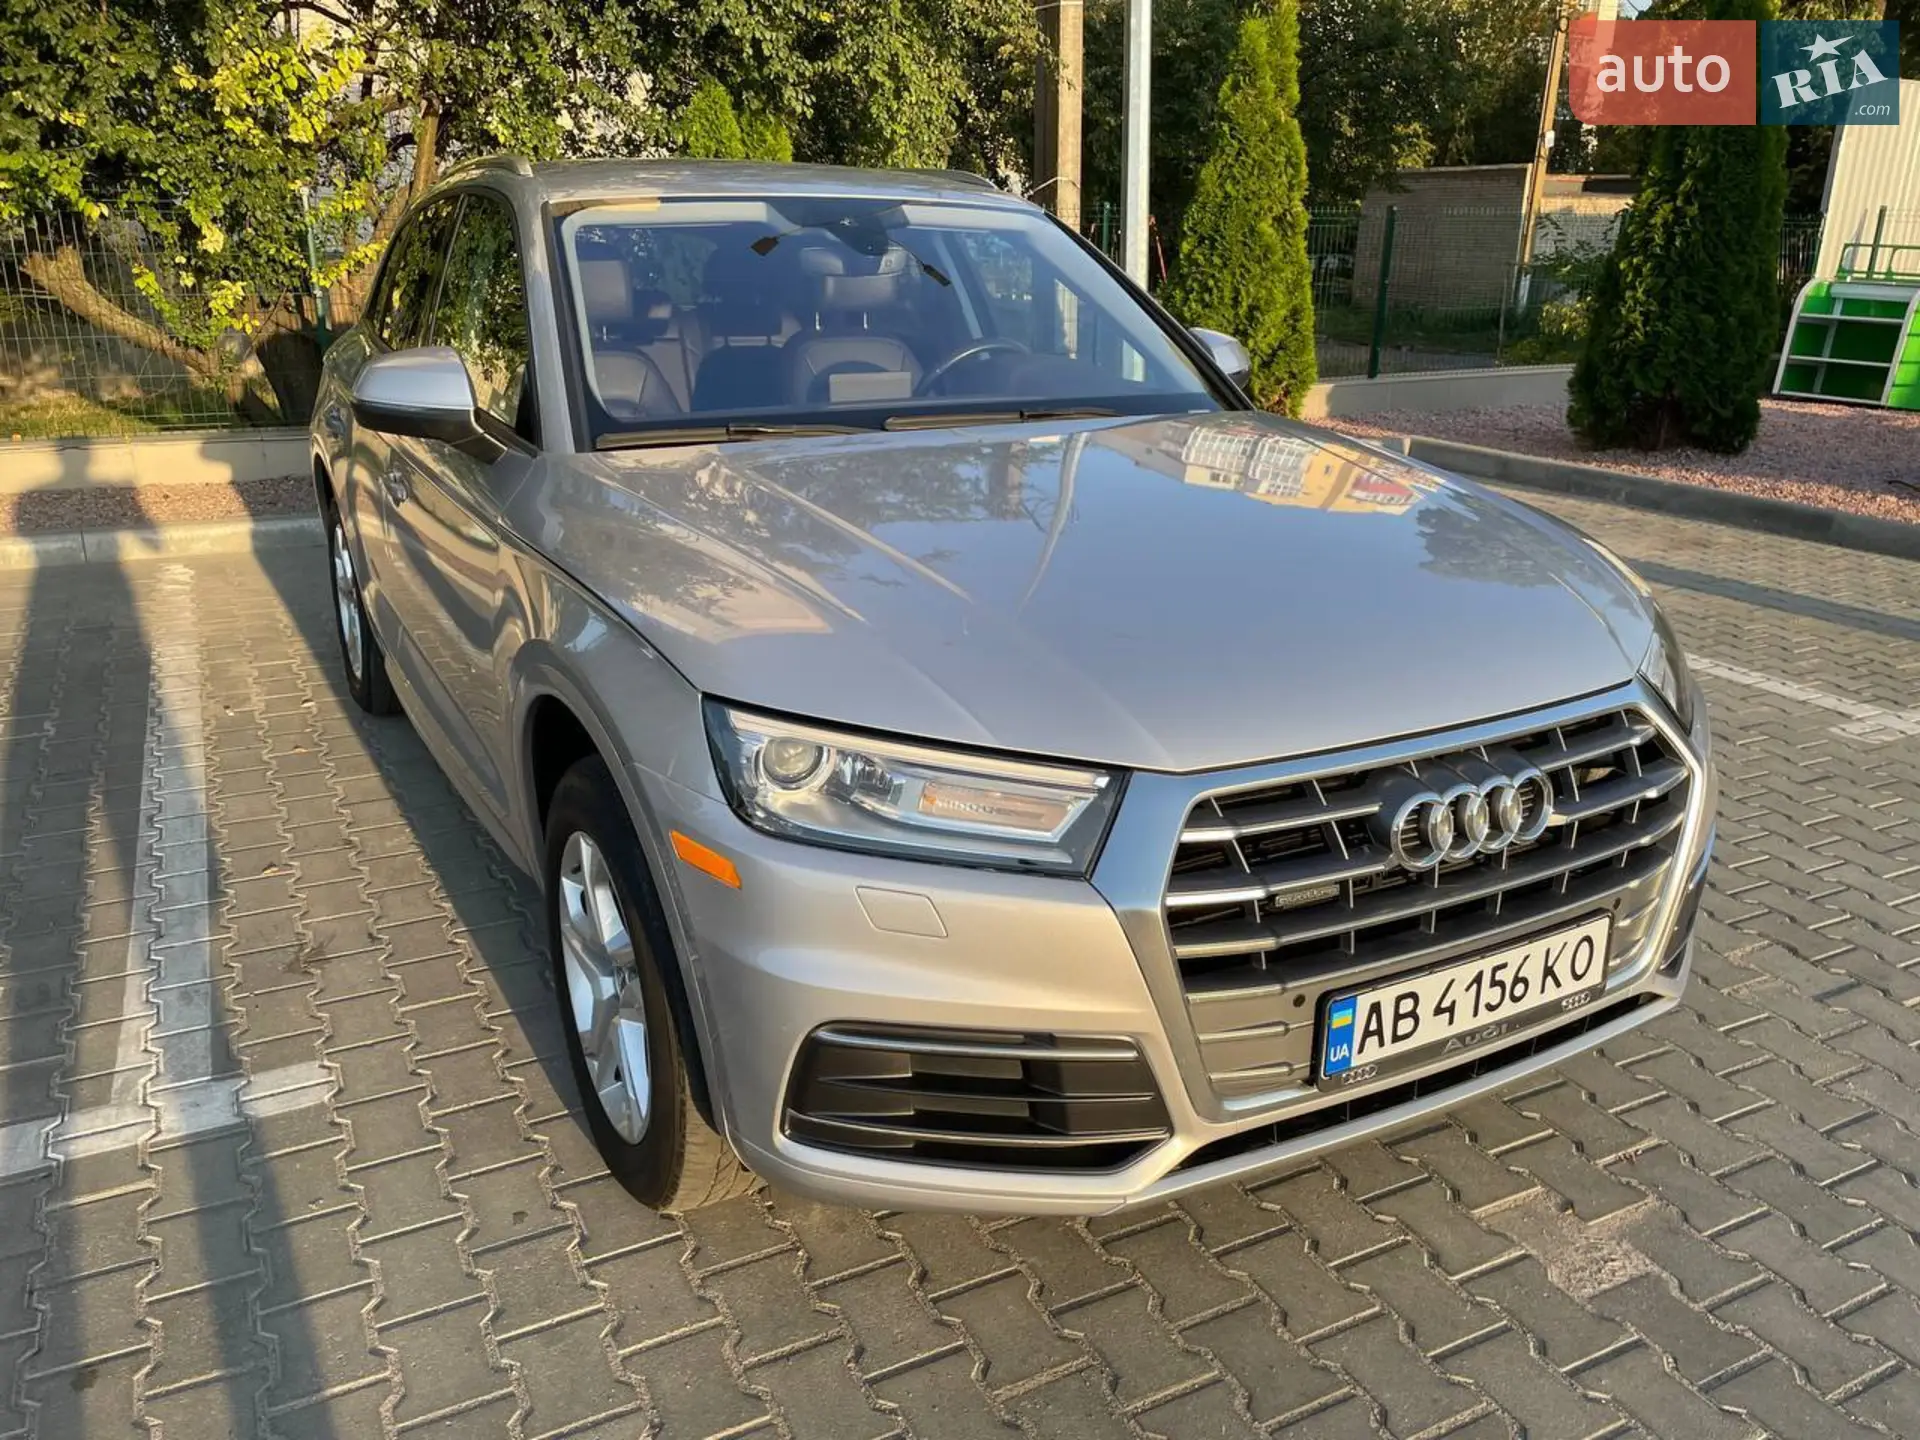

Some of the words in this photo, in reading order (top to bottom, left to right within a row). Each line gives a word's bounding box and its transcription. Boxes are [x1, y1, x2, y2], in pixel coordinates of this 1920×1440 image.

[1357, 991, 1420, 1055] AB
[1432, 954, 1530, 1026] 4156
[1540, 935, 1594, 995] KO
[1329, 1043, 1350, 1062] UA
